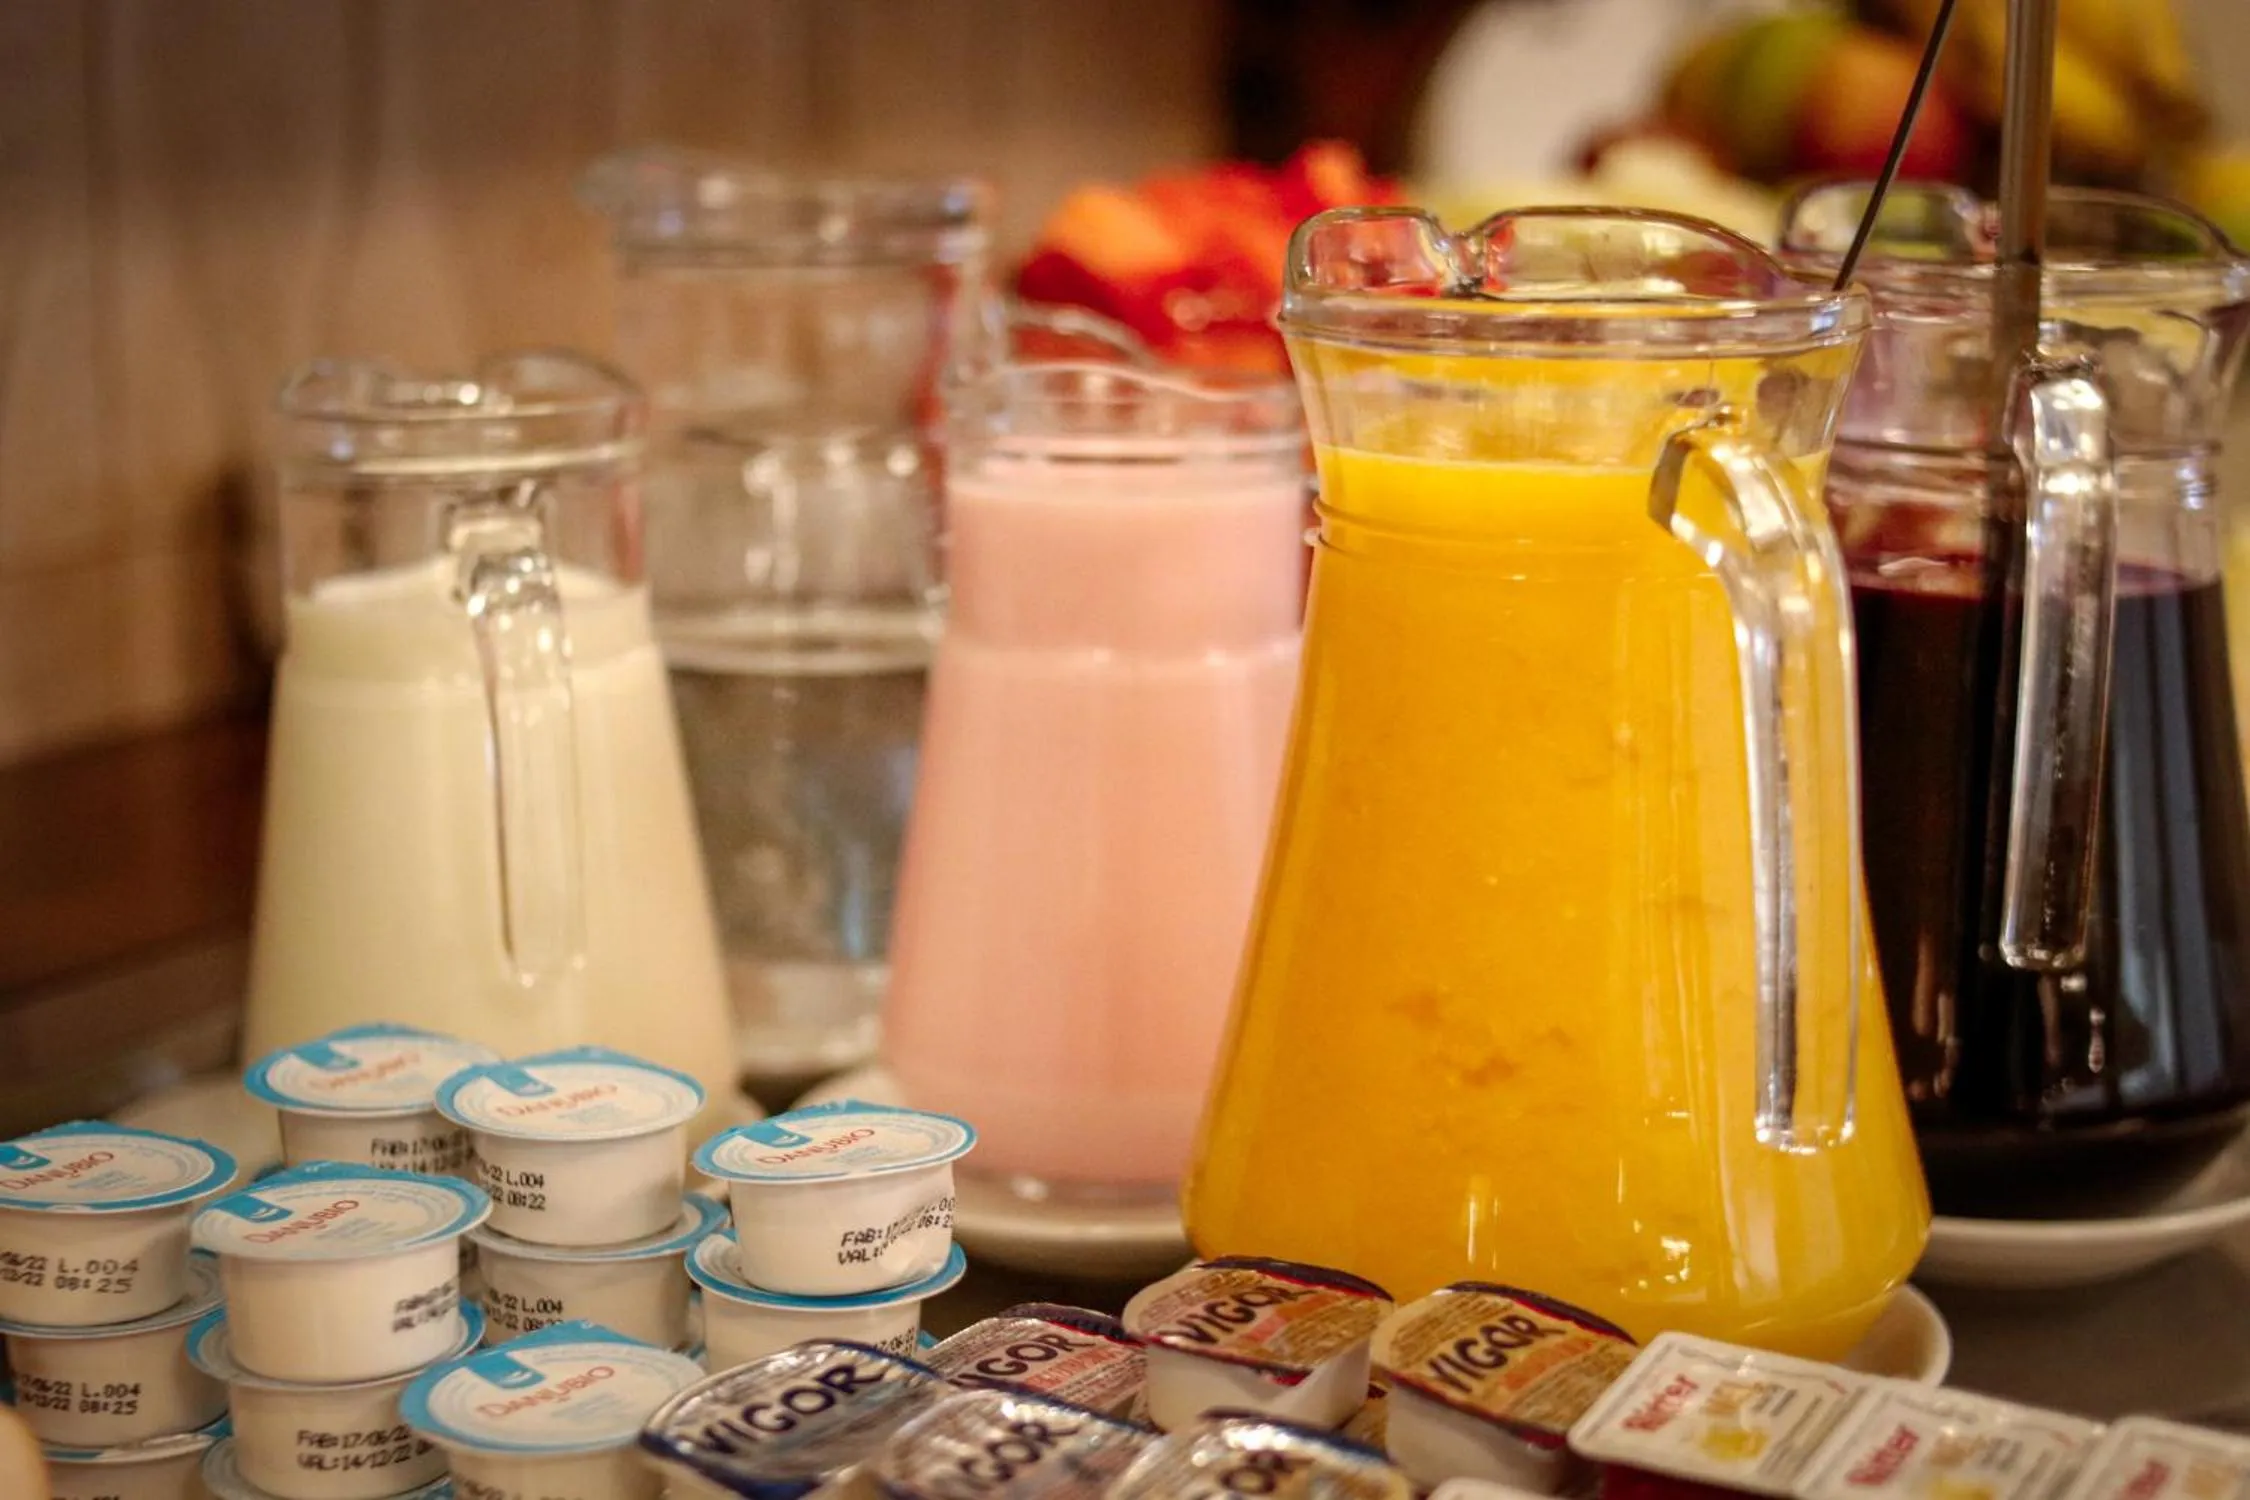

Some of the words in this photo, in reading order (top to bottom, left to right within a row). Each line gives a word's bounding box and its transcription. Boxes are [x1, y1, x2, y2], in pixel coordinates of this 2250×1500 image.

[495, 1083, 618, 1118] DANUBIO
[756, 1128, 876, 1165] DANUBIO
[505, 1170, 544, 1188] L.004
[242, 1199, 360, 1244] DANUBIO
[54, 1275, 134, 1294] 08:25
[57, 1257, 140, 1276] L.004
[521, 1297, 563, 1314] L.004
[1157, 1285, 1319, 1344] VIGOR
[947, 1333, 1096, 1389] IGOR
[1428, 1313, 1567, 1395] VIGOR
[78, 1399, 138, 1416] 08:25
[81, 1382, 142, 1399] L.004
[477, 1365, 615, 1417] DANUBIO
[677, 1363, 886, 1454] VIGOR
